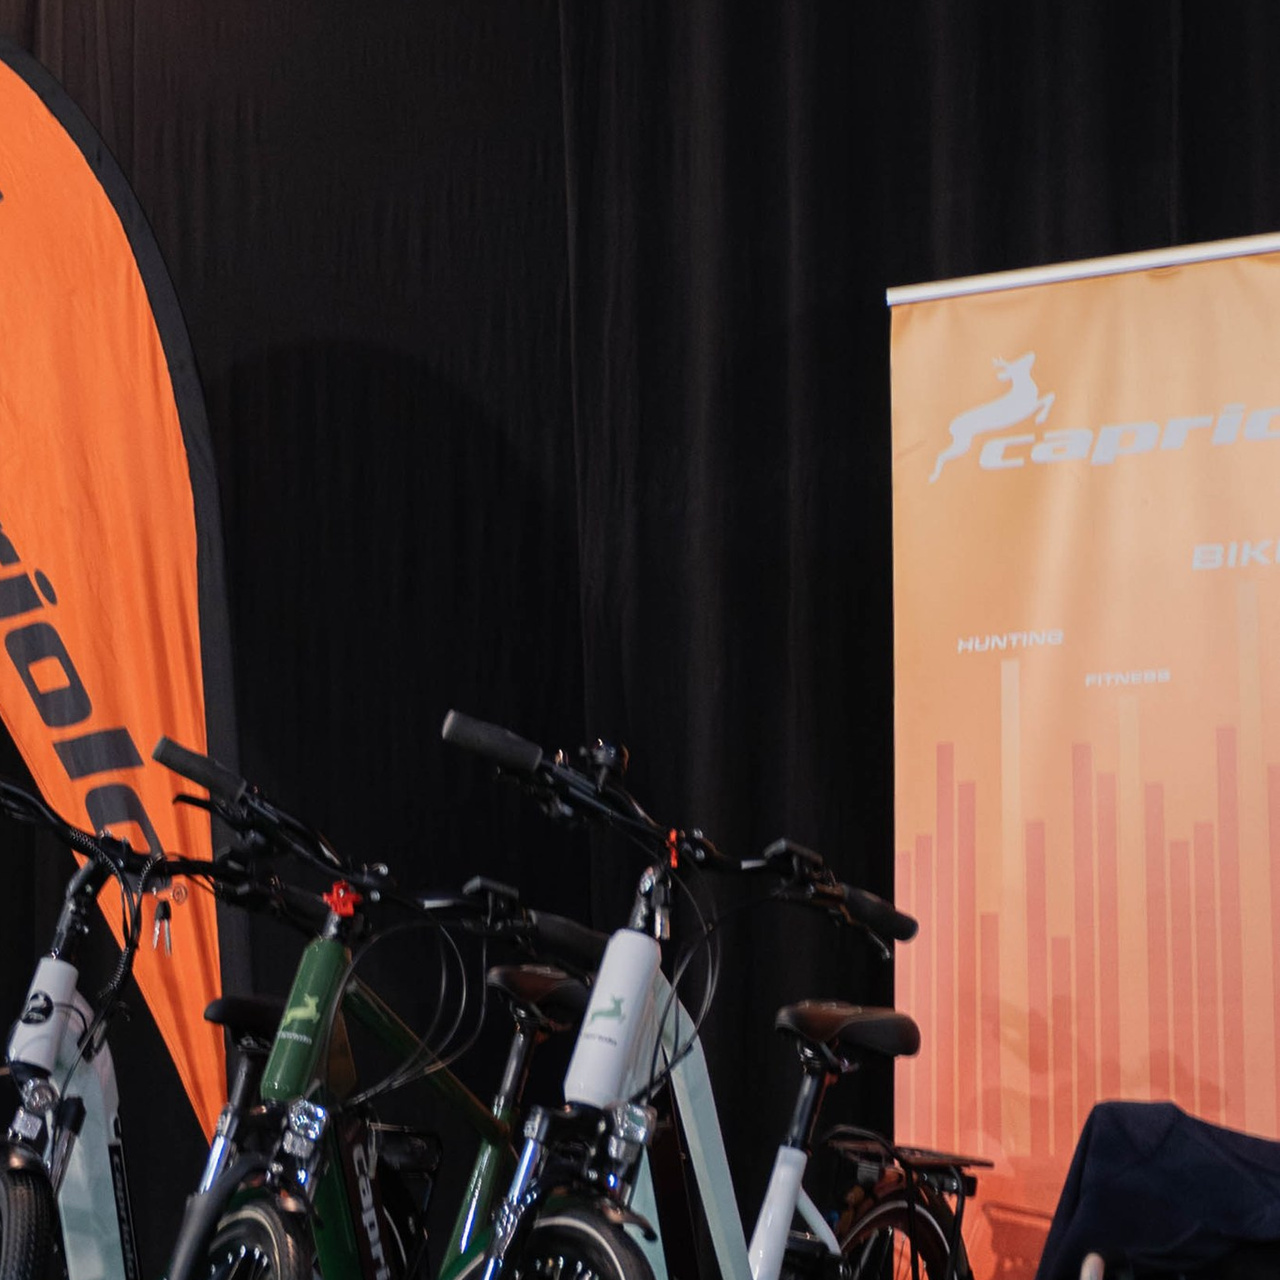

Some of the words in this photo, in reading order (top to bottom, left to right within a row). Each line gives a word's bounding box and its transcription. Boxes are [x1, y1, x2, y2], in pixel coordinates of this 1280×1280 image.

[1192, 539, 1280, 572] BIK
[957, 629, 1064, 653] HUNTING
[1084, 668, 1171, 687] FITNESS
